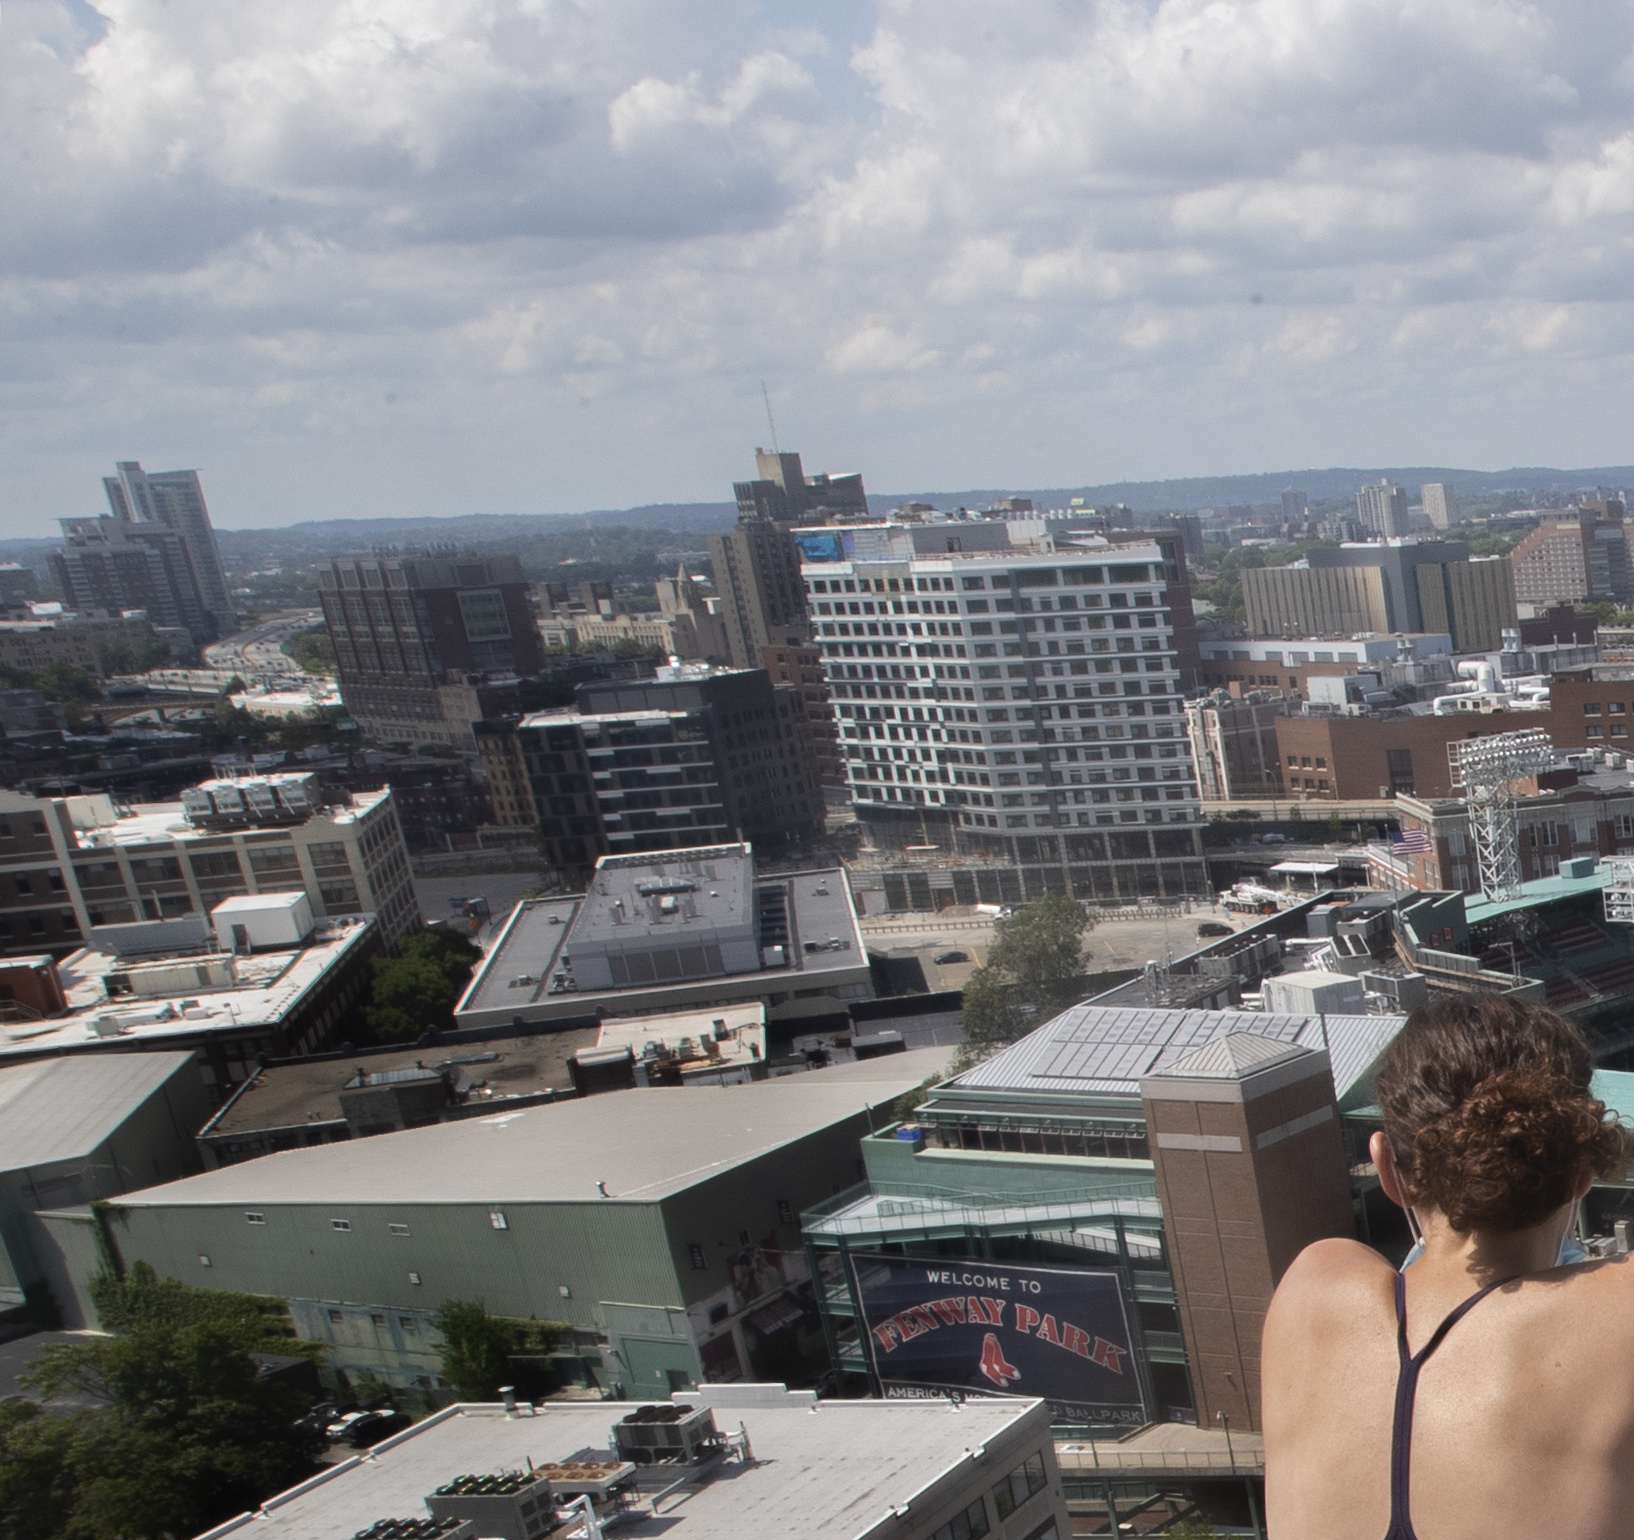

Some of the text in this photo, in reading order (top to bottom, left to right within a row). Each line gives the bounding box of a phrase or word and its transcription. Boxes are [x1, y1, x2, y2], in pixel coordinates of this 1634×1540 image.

[926, 1270, 1041, 1293] WELCOME TO
[873, 1296, 1006, 1353] FENWAY
[1015, 1302, 1128, 1375] PARK
[887, 1387, 960, 1402] AMERICA'S
[1066, 1406, 1142, 1422] BALLPARK
